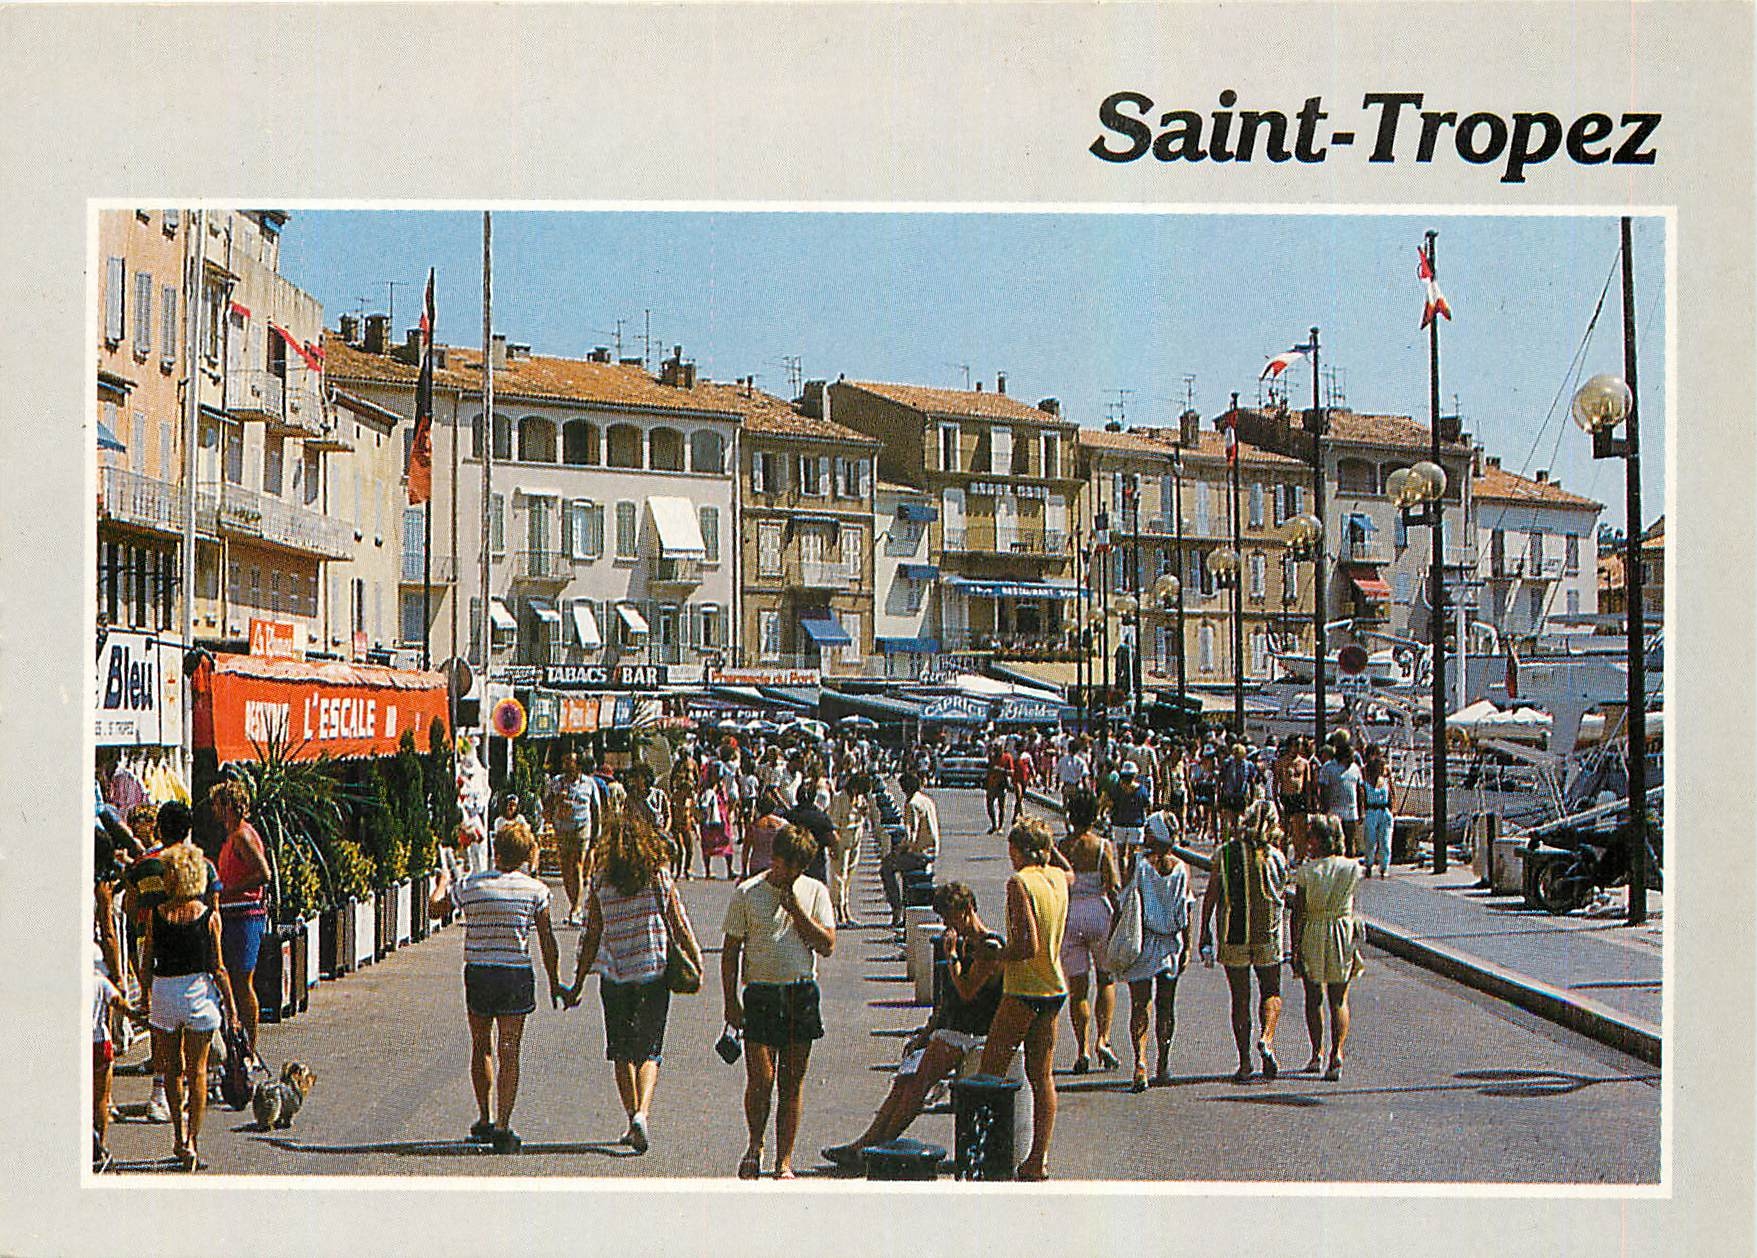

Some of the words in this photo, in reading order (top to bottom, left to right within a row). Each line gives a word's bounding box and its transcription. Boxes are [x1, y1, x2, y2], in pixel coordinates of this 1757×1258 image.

[103, 645, 153, 711] Bleu
[545, 667, 608, 683] TABACS
[622, 667, 658, 685] BAR
[303, 691, 377, 740] L'ESCALE
[924, 696, 986, 717] CAPRICE
